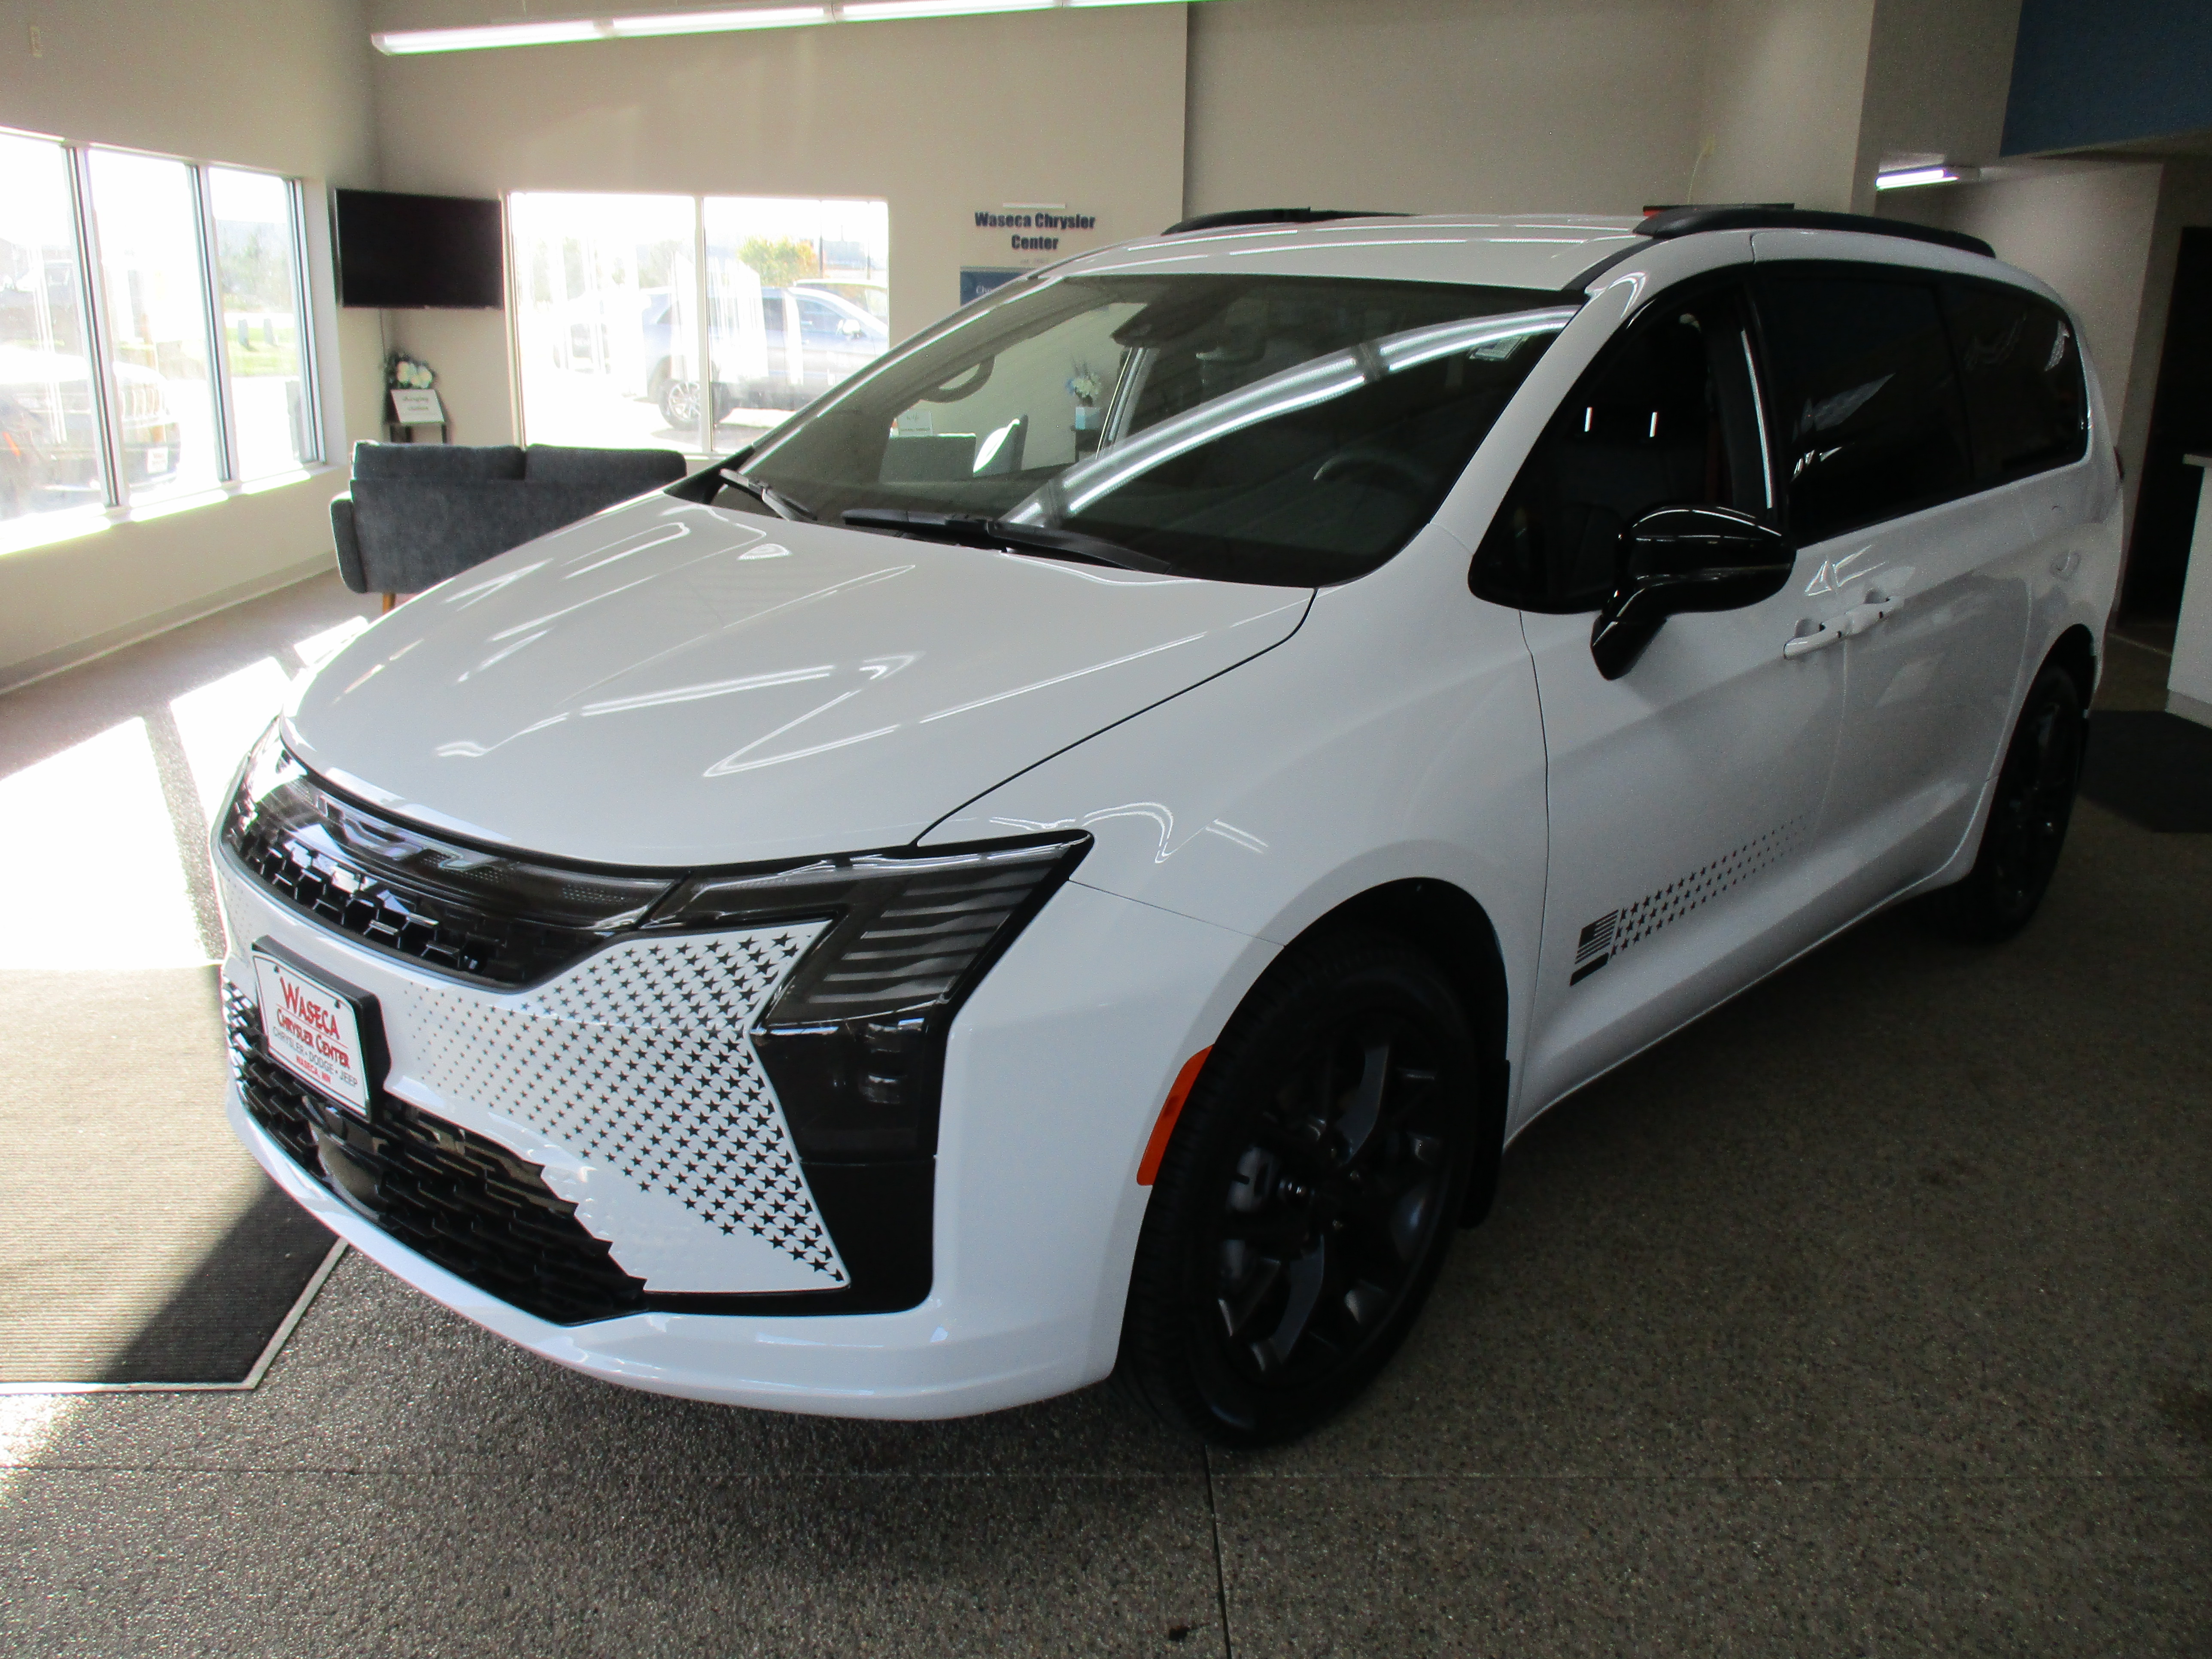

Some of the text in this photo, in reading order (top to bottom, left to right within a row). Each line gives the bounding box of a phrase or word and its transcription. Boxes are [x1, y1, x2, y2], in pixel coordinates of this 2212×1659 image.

[975, 211, 1095, 229] Waseca Chrysler
[1012, 234, 1058, 249] Center
[280, 977, 340, 1039] WASECA
[273, 1026, 358, 1087] CHRYSLER DODGE JEEP
[277, 1009, 350, 1069] CHRYSLER CENTER
